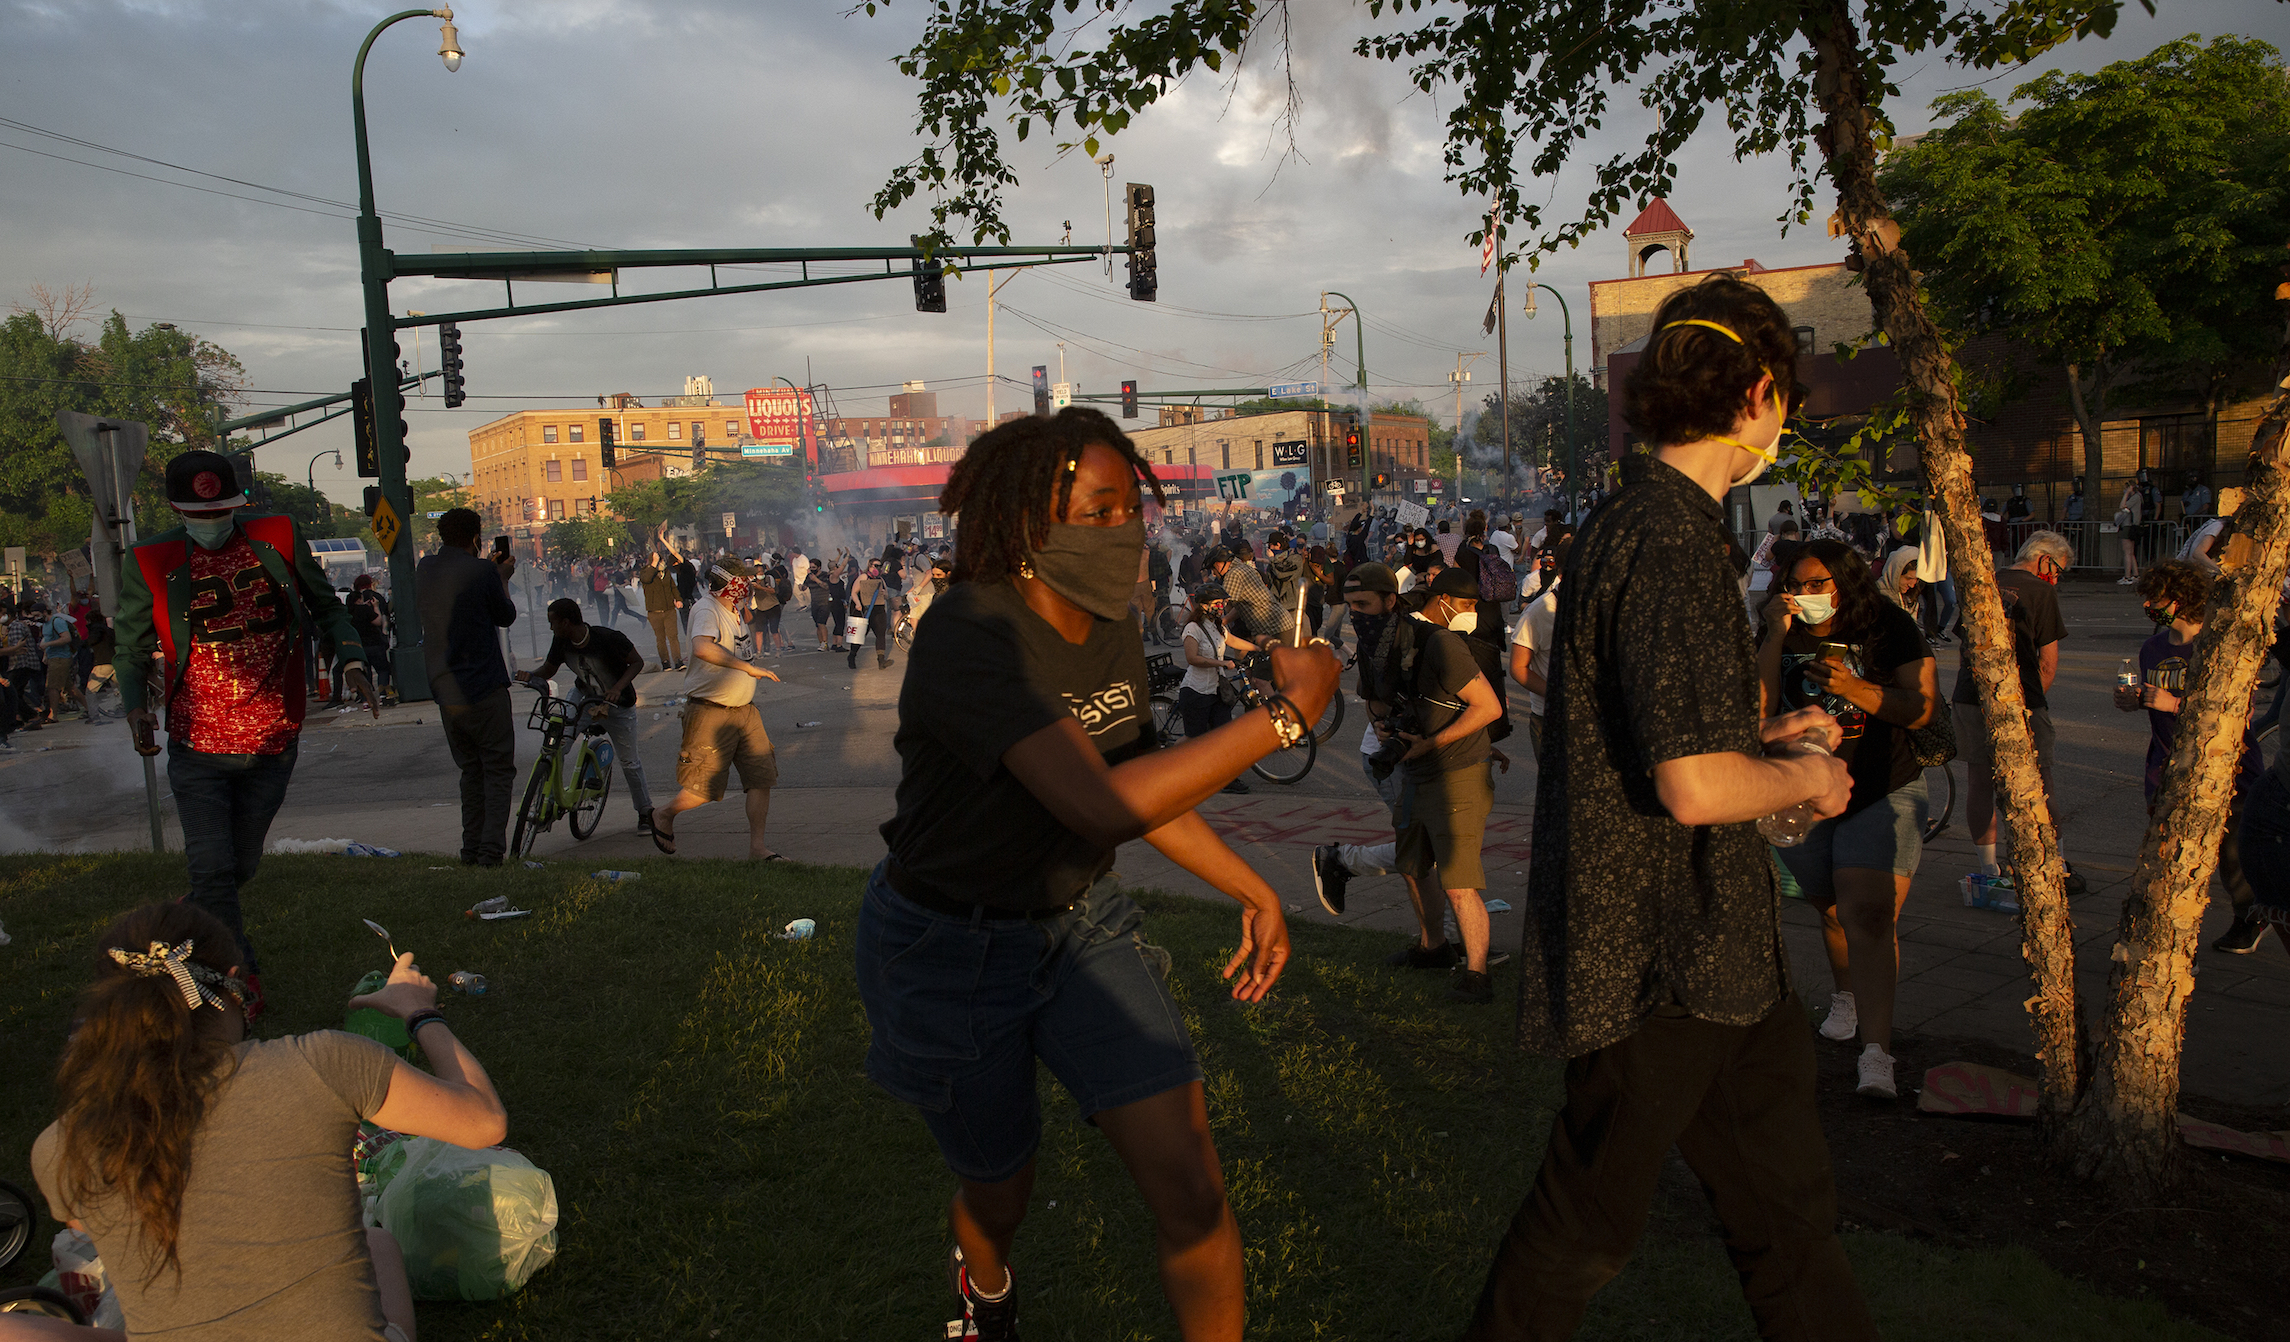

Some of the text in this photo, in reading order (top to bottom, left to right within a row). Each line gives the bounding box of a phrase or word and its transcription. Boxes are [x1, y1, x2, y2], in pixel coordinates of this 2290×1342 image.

[1281, 386, 1301, 394] Lake
[1160, 484, 1180, 496] Spirits
[1216, 473, 1251, 499] FTP
[1404, 502, 1424, 516] BLACK
[1404, 510, 1422, 520] LIVES
[1399, 514, 1422, 527] MATTER
[190, 563, 288, 643] 23
